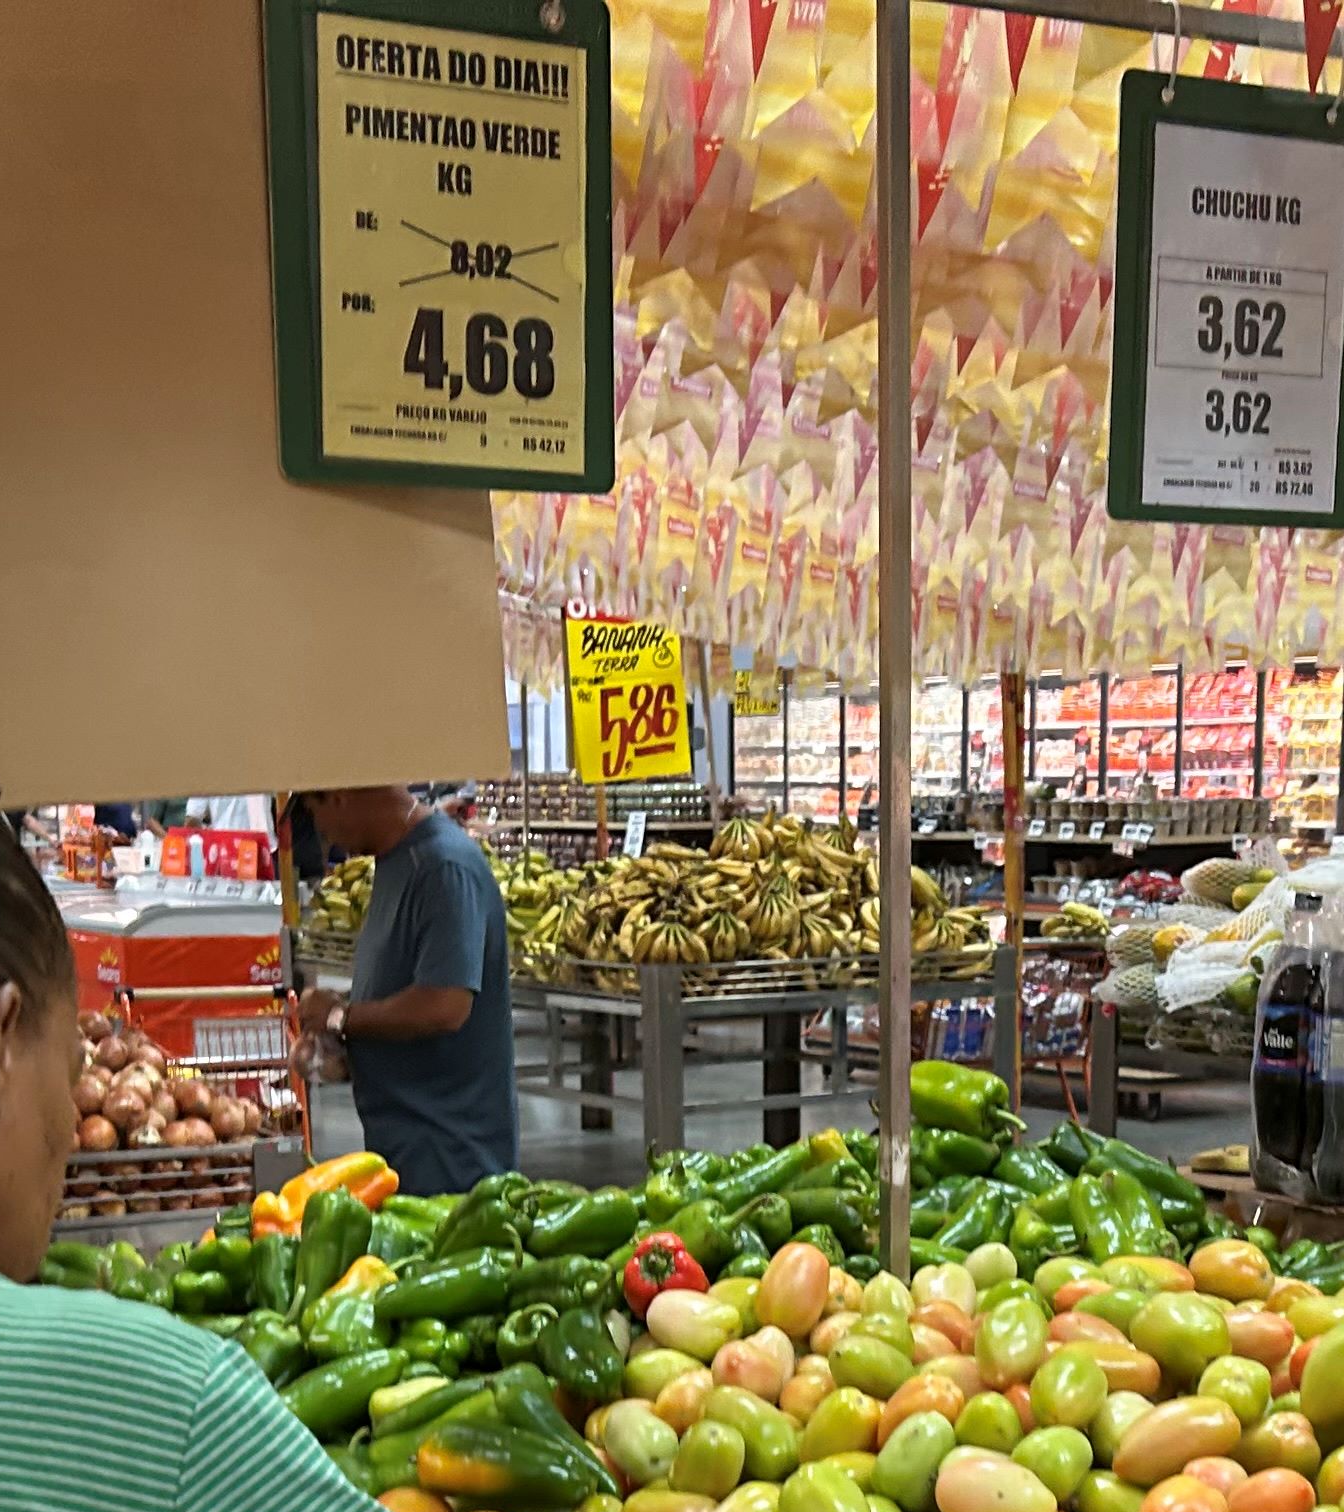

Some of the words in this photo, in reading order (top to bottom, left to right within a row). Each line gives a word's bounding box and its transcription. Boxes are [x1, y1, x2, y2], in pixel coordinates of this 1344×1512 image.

[335, 33, 441, 81] OFERTA
[449, 50, 487, 88] DO
[494, 56, 570, 99] DIA!!!
[344, 103, 476, 150] PIMENTAO
[483, 121, 561, 161] VERDE
[437, 162, 473, 197] KG
[1191, 185, 1271, 223] CHUCHU
[1275, 194, 1302, 227] KG
[450, 240, 513, 281] 8,02
[1197, 294, 1288, 362] 3,62
[402, 306, 556, 401] 4,68
[1205, 388, 1272, 438] 3,62
[249, 963, 282, 983] Sea
